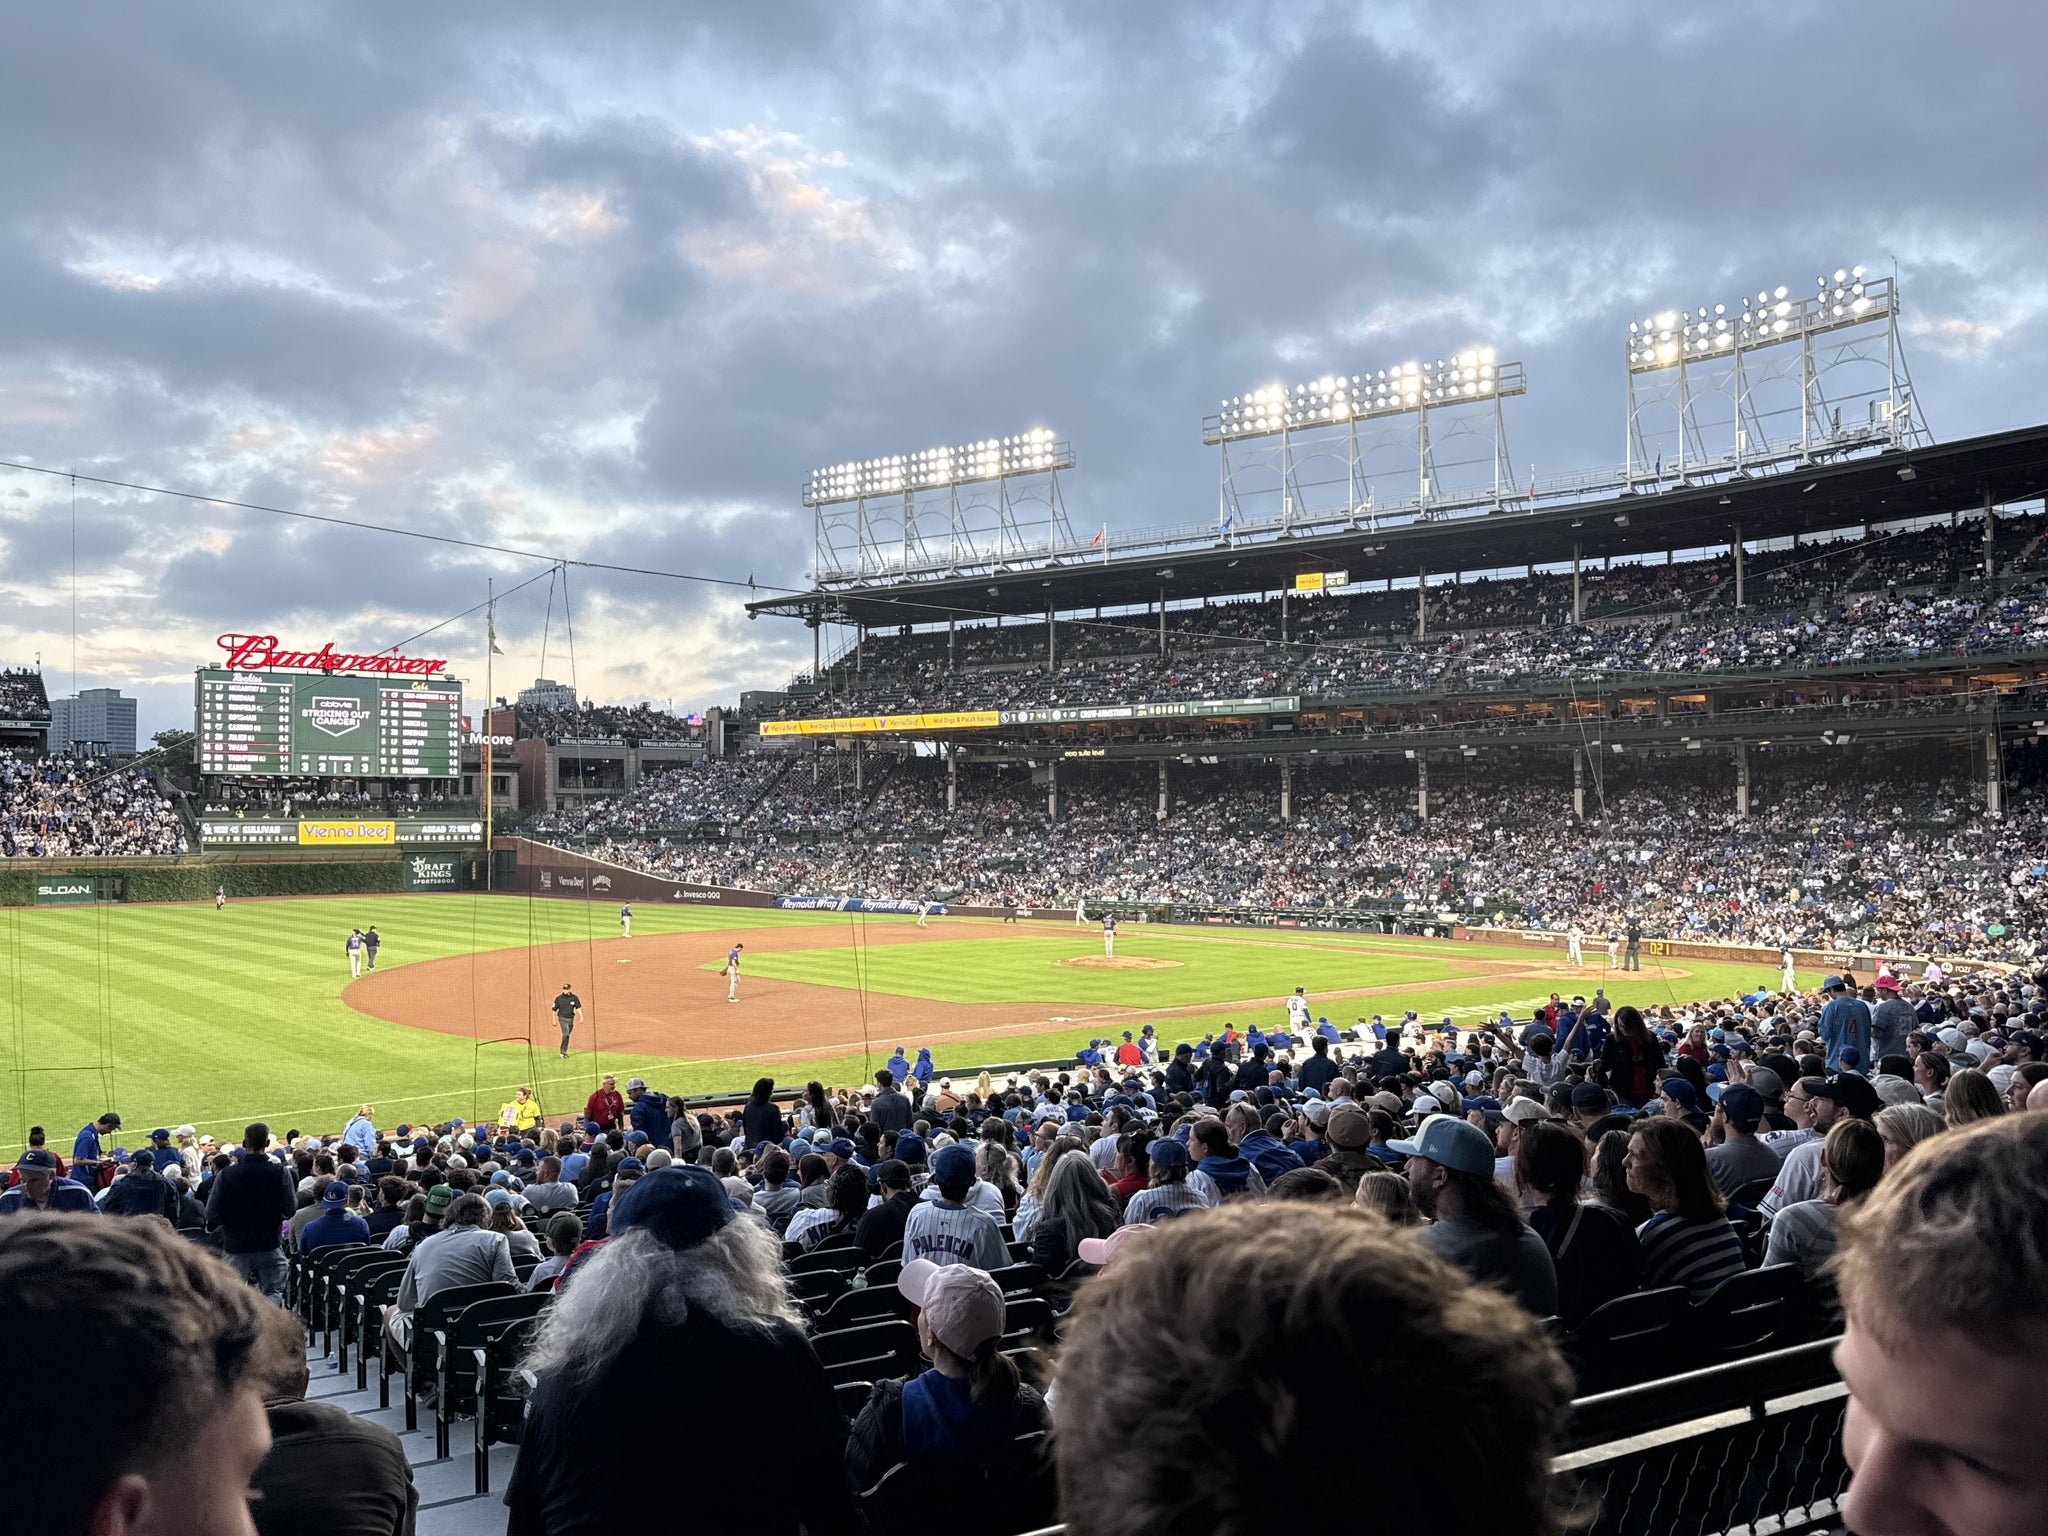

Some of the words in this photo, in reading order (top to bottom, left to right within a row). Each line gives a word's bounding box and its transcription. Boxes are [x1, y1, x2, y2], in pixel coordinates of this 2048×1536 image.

[217, 634, 448, 674] Budweiser
[233, 673, 262, 682] Rockies
[412, 682, 428, 690] Cubs
[302, 709, 349, 718] STRIKING
[470, 733, 513, 745] Moore
[301, 762, 309, 772] 3
[318, 762, 326, 772] 2
[344, 763, 352, 773] 2
[361, 763, 369, 773] 3
[304, 824, 354, 837] Vienna
[358, 825, 390, 840] Beef
[413, 863, 453, 872] DRAFT
[592, 875, 611, 888] MARQUEE
[38, 885, 90, 894] SLOAN
[684, 890, 706, 898] Invesco
[782, 899, 816, 909] Reynolds
[816, 900, 837, 909] Wrap
[860, 900, 897, 911] Reynolds
[1650, 943, 1670, 955] 021
[1848, 1018, 1858, 1039] 4
[26, 1152, 35, 1160] C
[912, 1234, 974, 1260] PALENCIA
